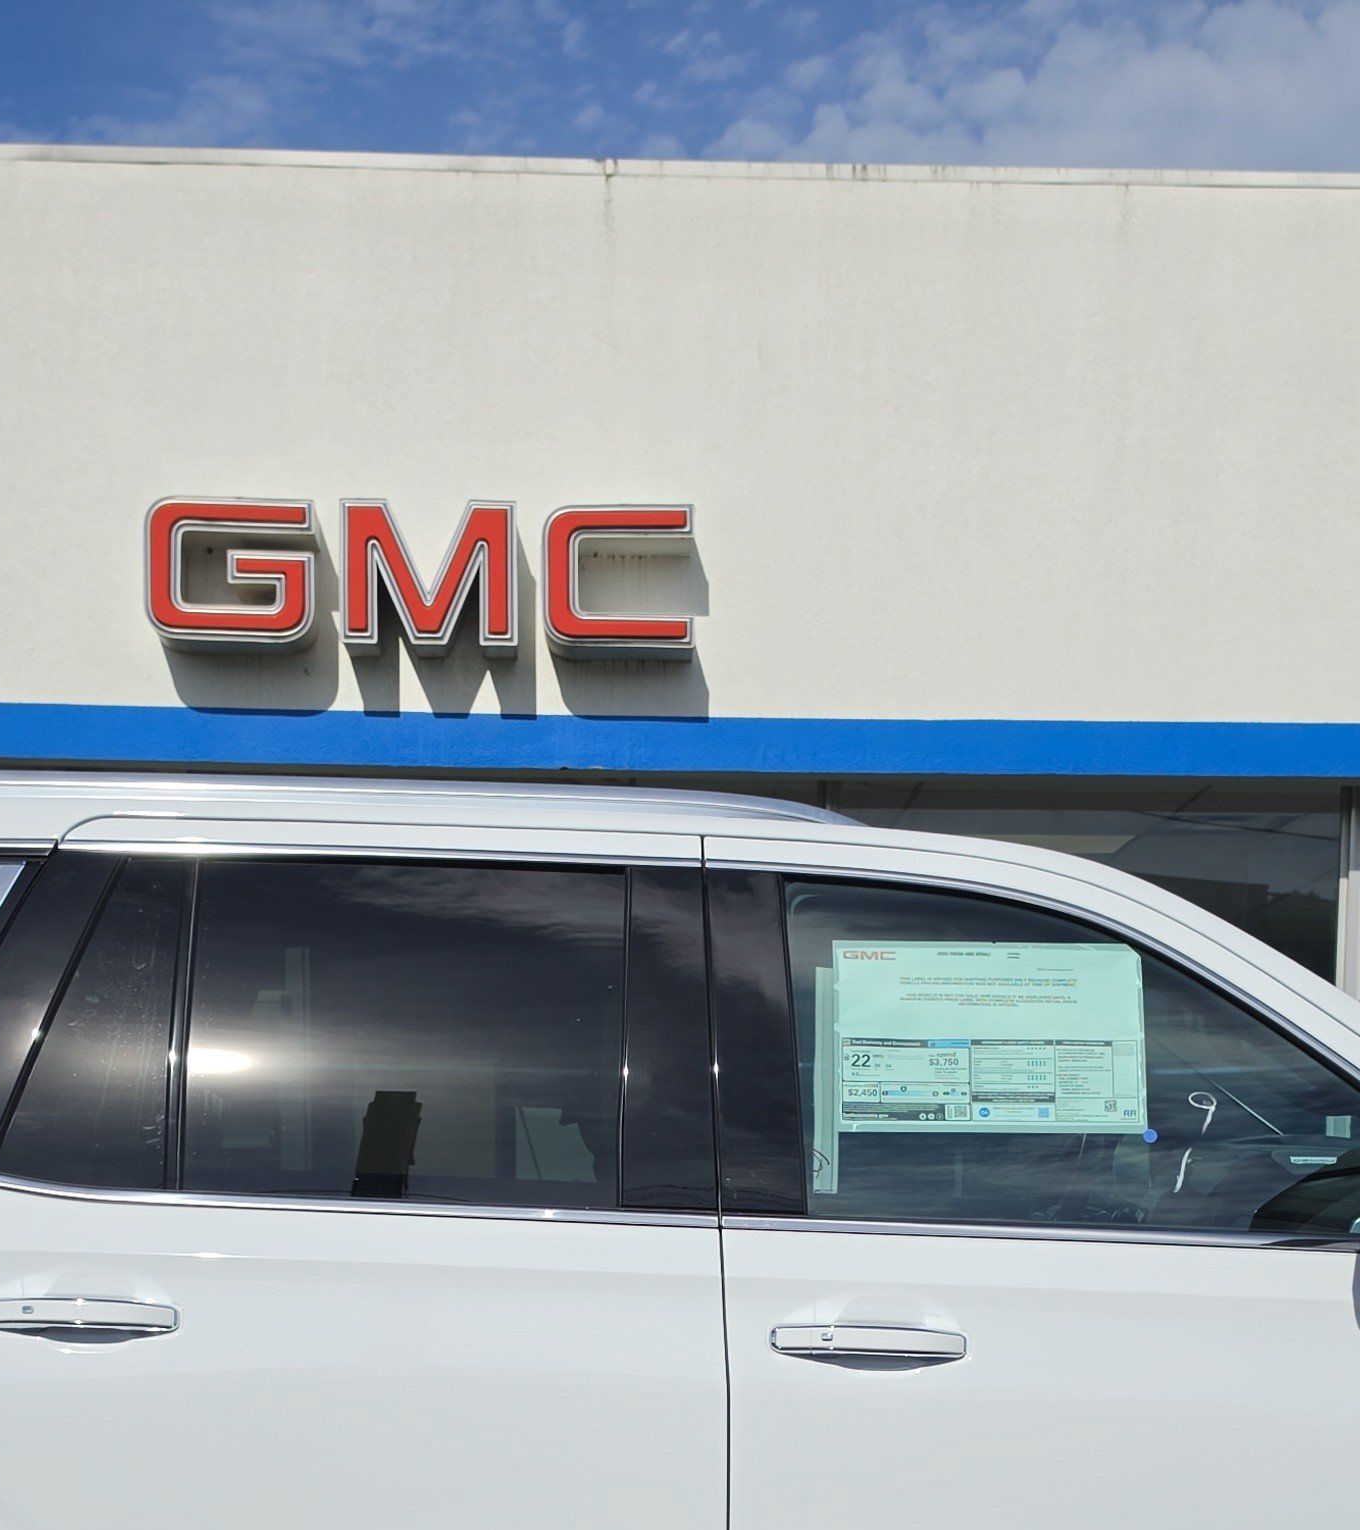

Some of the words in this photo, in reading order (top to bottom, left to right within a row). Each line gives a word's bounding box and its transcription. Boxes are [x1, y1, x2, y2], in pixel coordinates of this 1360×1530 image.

[144, 495, 696, 656] GMC
[842, 950, 897, 961] GMC
[851, 1053, 871, 1068] 22
[928, 1058, 960, 1067] $3,750
[848, 1088, 878, 1097] $2,450
